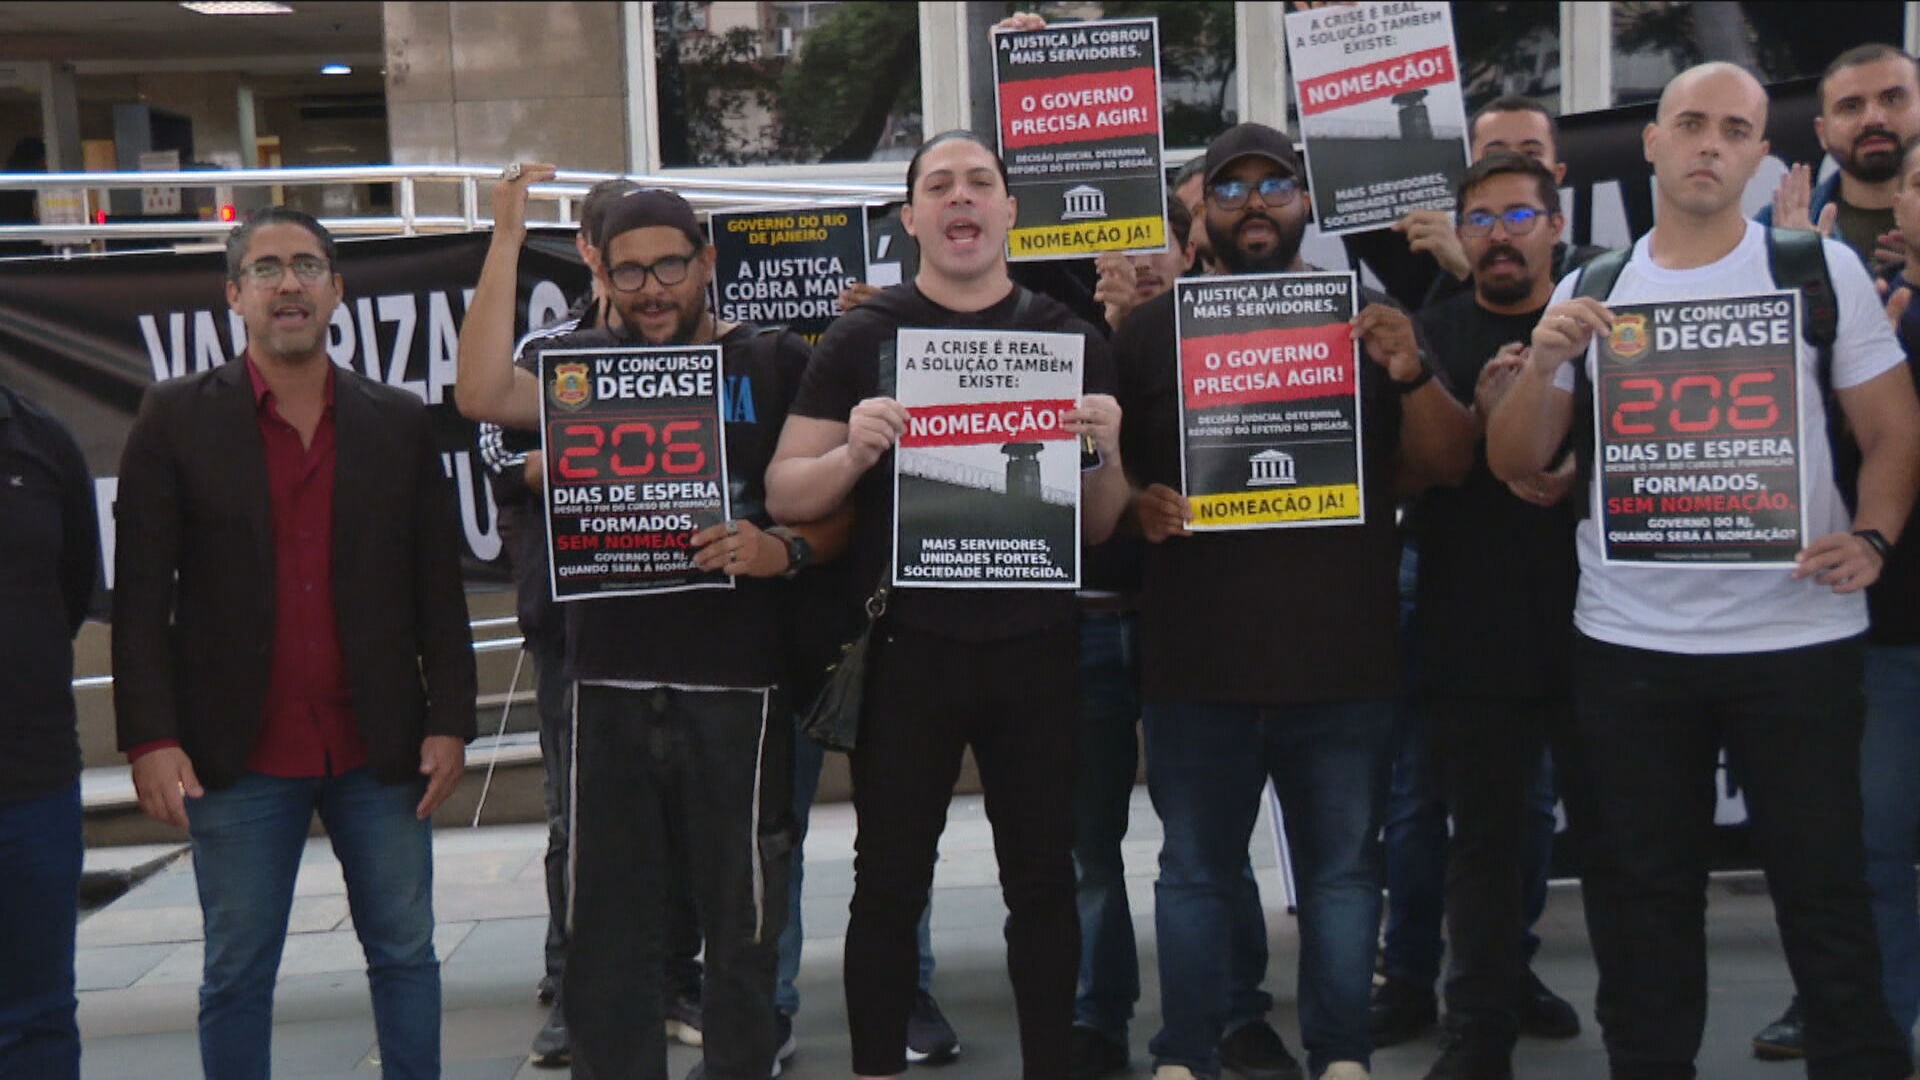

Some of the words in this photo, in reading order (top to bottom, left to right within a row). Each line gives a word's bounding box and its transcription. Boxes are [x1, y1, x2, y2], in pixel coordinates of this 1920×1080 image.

[1311, 19, 1320, 30] A
[1324, 11, 1365, 28] CRISE
[1370, 7, 1376, 19] É
[1384, 2, 1422, 16] REAL.
[1000, 38, 1010, 50] A
[1014, 35, 1067, 50] JUSTIÇA
[1072, 32, 1087, 48] JÁ
[1091, 29, 1150, 44] COBROU
[1297, 38, 1305, 48] A
[1344, 35, 1397, 54] EXISTE:
[1010, 51, 1045, 64] MAIS
[1050, 46, 1141, 63] SERVIDORES.
[1307, 55, 1444, 105] NOMEAÇÃO!
[1021, 97, 1036, 112] O
[1041, 86, 1134, 110] GOVERNO
[1012, 116, 1093, 135] PRECISA
[1096, 107, 1148, 126] AGIR!
[1335, 187, 1366, 199] MAIS
[728, 217, 794, 232] GOVERNO
[799, 216, 818, 228] DO
[824, 214, 847, 226] RIO
[750, 233, 767, 244] DE
[770, 229, 828, 245] JANEIRO
[1020, 227, 1120, 250] NOMEAÇÃO
[1126, 225, 1151, 244] JÁ!
[738, 262, 753, 278] A
[758, 257, 843, 279] JUSTIÇA
[725, 280, 798, 300] COBRA
[1183, 291, 1194, 303] A
[1198, 288, 1256, 304] JUSTIÇA
[1263, 284, 1278, 300] JÁ
[1283, 283, 1347, 297] COBROU
[723, 300, 844, 321] SERVIDORE
[1193, 306, 1231, 318] MAIS
[1237, 299, 1338, 316] SERVIDORES.
[1655, 309, 1673, 324] IV
[1679, 302, 1790, 322] CONCURSO
[1656, 319, 1790, 350] DEGASE
[926, 342, 935, 354] A
[941, 341, 987, 354] CRISE
[994, 339, 1002, 354] É
[1009, 342, 1053, 356] REAL.
[1205, 353, 1220, 369] O
[1227, 343, 1329, 368] GOVERNO
[595, 360, 613, 373] IV
[618, 356, 713, 372] CONCURSO
[906, 358, 916, 370] A
[922, 356, 998, 374] SOLUÇÃO
[1005, 357, 1073, 373] TAMBÉM
[597, 373, 713, 400] DEGASE
[960, 375, 1020, 388] EXISTE:
[1194, 374, 1281, 394] PRECISA
[1287, 367, 1343, 386] AGIR!
[1612, 372, 1779, 434] 206
[1235, 426, 1249, 435] DO
[559, 421, 705, 478] 206
[1606, 445, 1658, 462] DIAS
[1667, 444, 1696, 459] DE
[1704, 439, 1793, 458] ESPERA
[554, 486, 602, 504] DIAS
[609, 485, 635, 502] DE
[643, 482, 719, 500] ESPERA
[1633, 474, 1767, 494] FORMADOS.
[1201, 493, 1311, 518] NOMEAÇÃO
[1319, 492, 1344, 512] JÁ!
[1608, 498, 1655, 514] SEM
[1661, 490, 1796, 513] NOMEAÇÃO.
[580, 515, 698, 532] FORMADOS.
[1648, 518, 1710, 528] GOVERNO
[1714, 518, 1733, 527] DO
[558, 534, 598, 550] SEM
[605, 530, 699, 549] NOMEAÇ
[922, 539, 956, 550] MAIS
[960, 539, 1050, 551] SERVIDORES,
[1609, 532, 1663, 542] QUANDO
[1703, 531, 1713, 540] A
[594, 553, 649, 562] GOVERNO
[653, 552, 669, 561] DO
[920, 553, 990, 564] UNIDADES
[995, 552, 1052, 565] FORTES,
[559, 565, 608, 576] QUANDO
[644, 564, 652, 572] A
[904, 565, 981, 577] SOCIEDADE
[986, 566, 1068, 578] PROTEGIDA.
